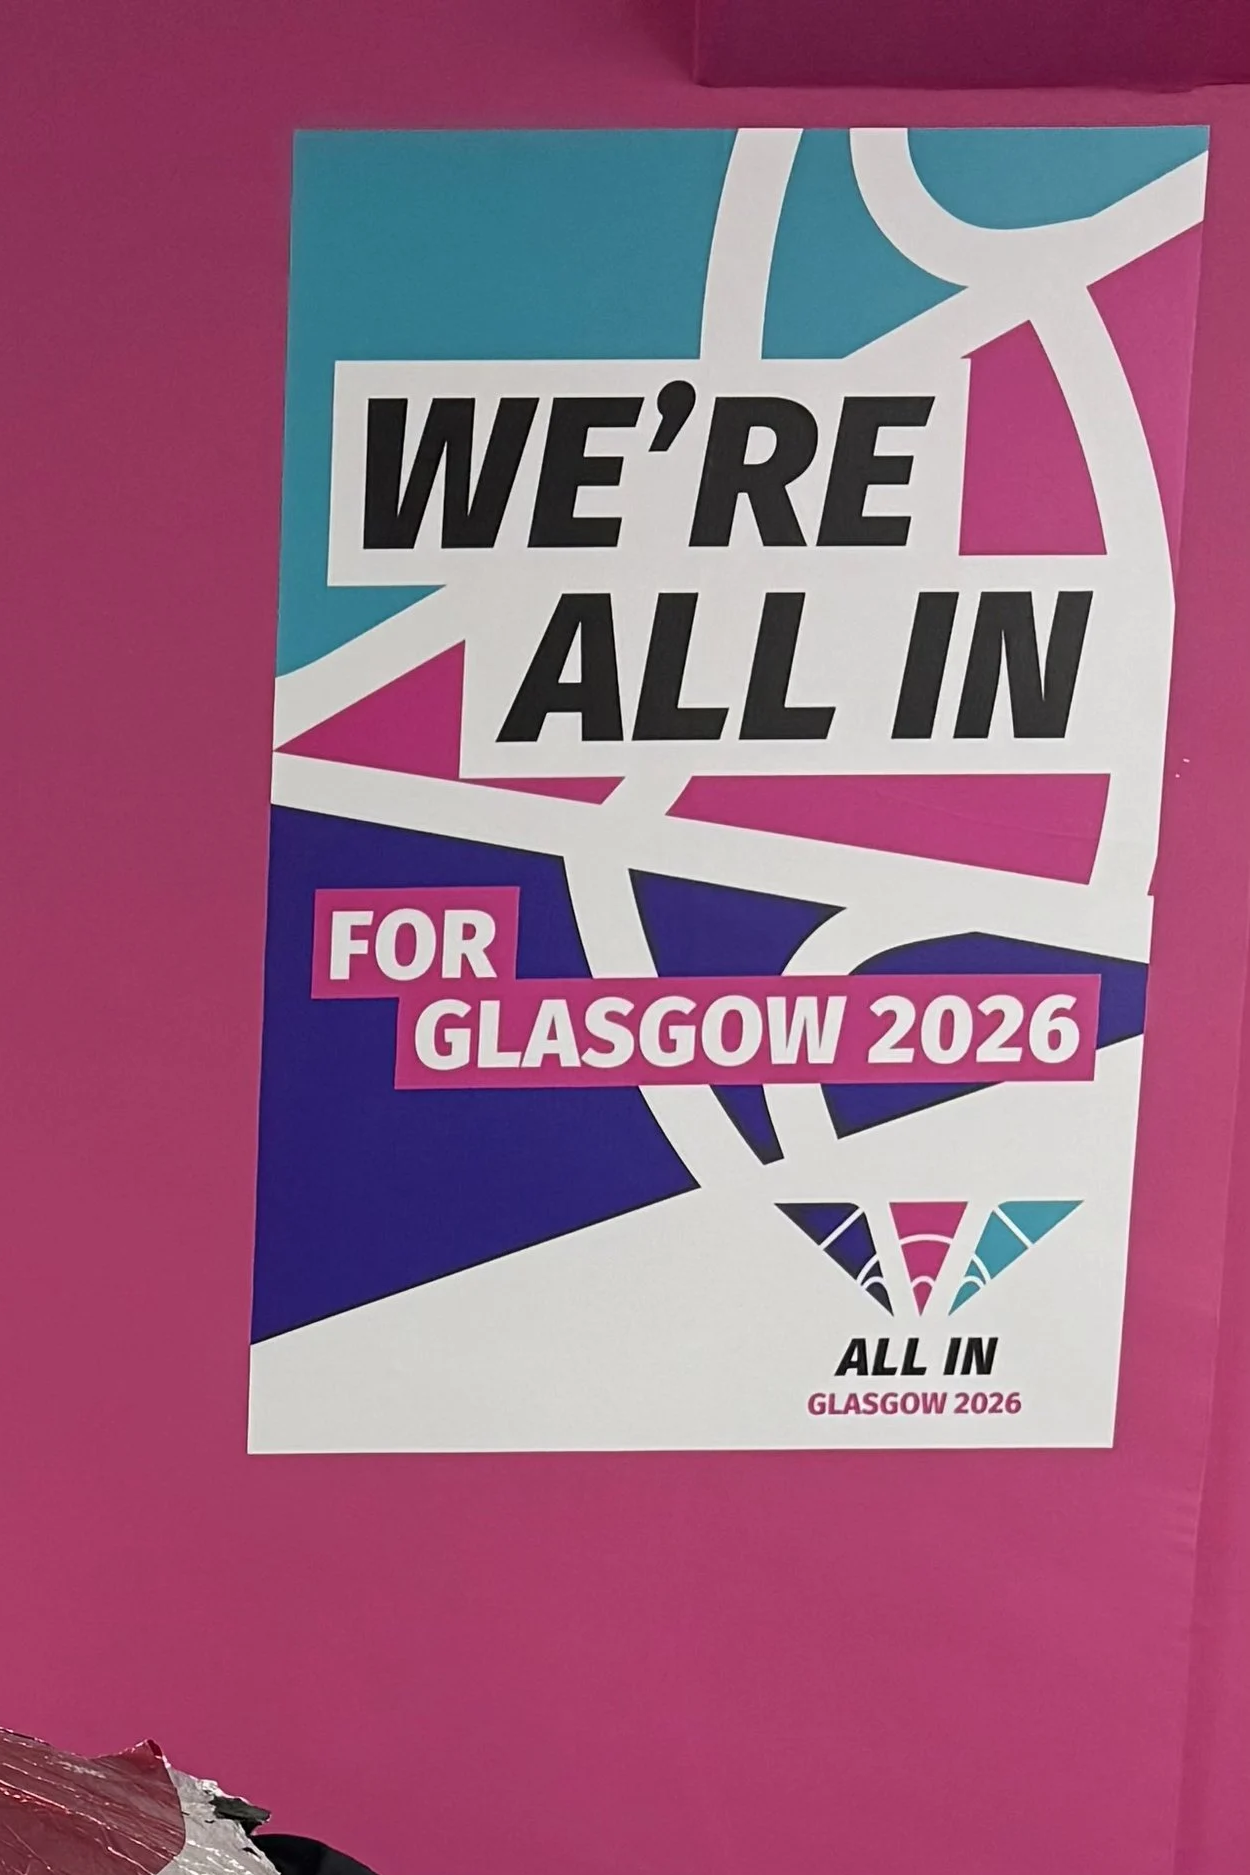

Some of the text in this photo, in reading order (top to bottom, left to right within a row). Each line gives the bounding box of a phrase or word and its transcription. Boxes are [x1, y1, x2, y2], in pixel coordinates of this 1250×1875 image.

[362, 379, 937, 551] WE’RE
[494, 589, 1095, 744] ALL IN
[328, 907, 498, 982] FOR
[413, 992, 1081, 1071] GLASGOW 2026
[834, 1335, 1000, 1377] ALL IN
[806, 1391, 1023, 1418] GLASGOW 2026
